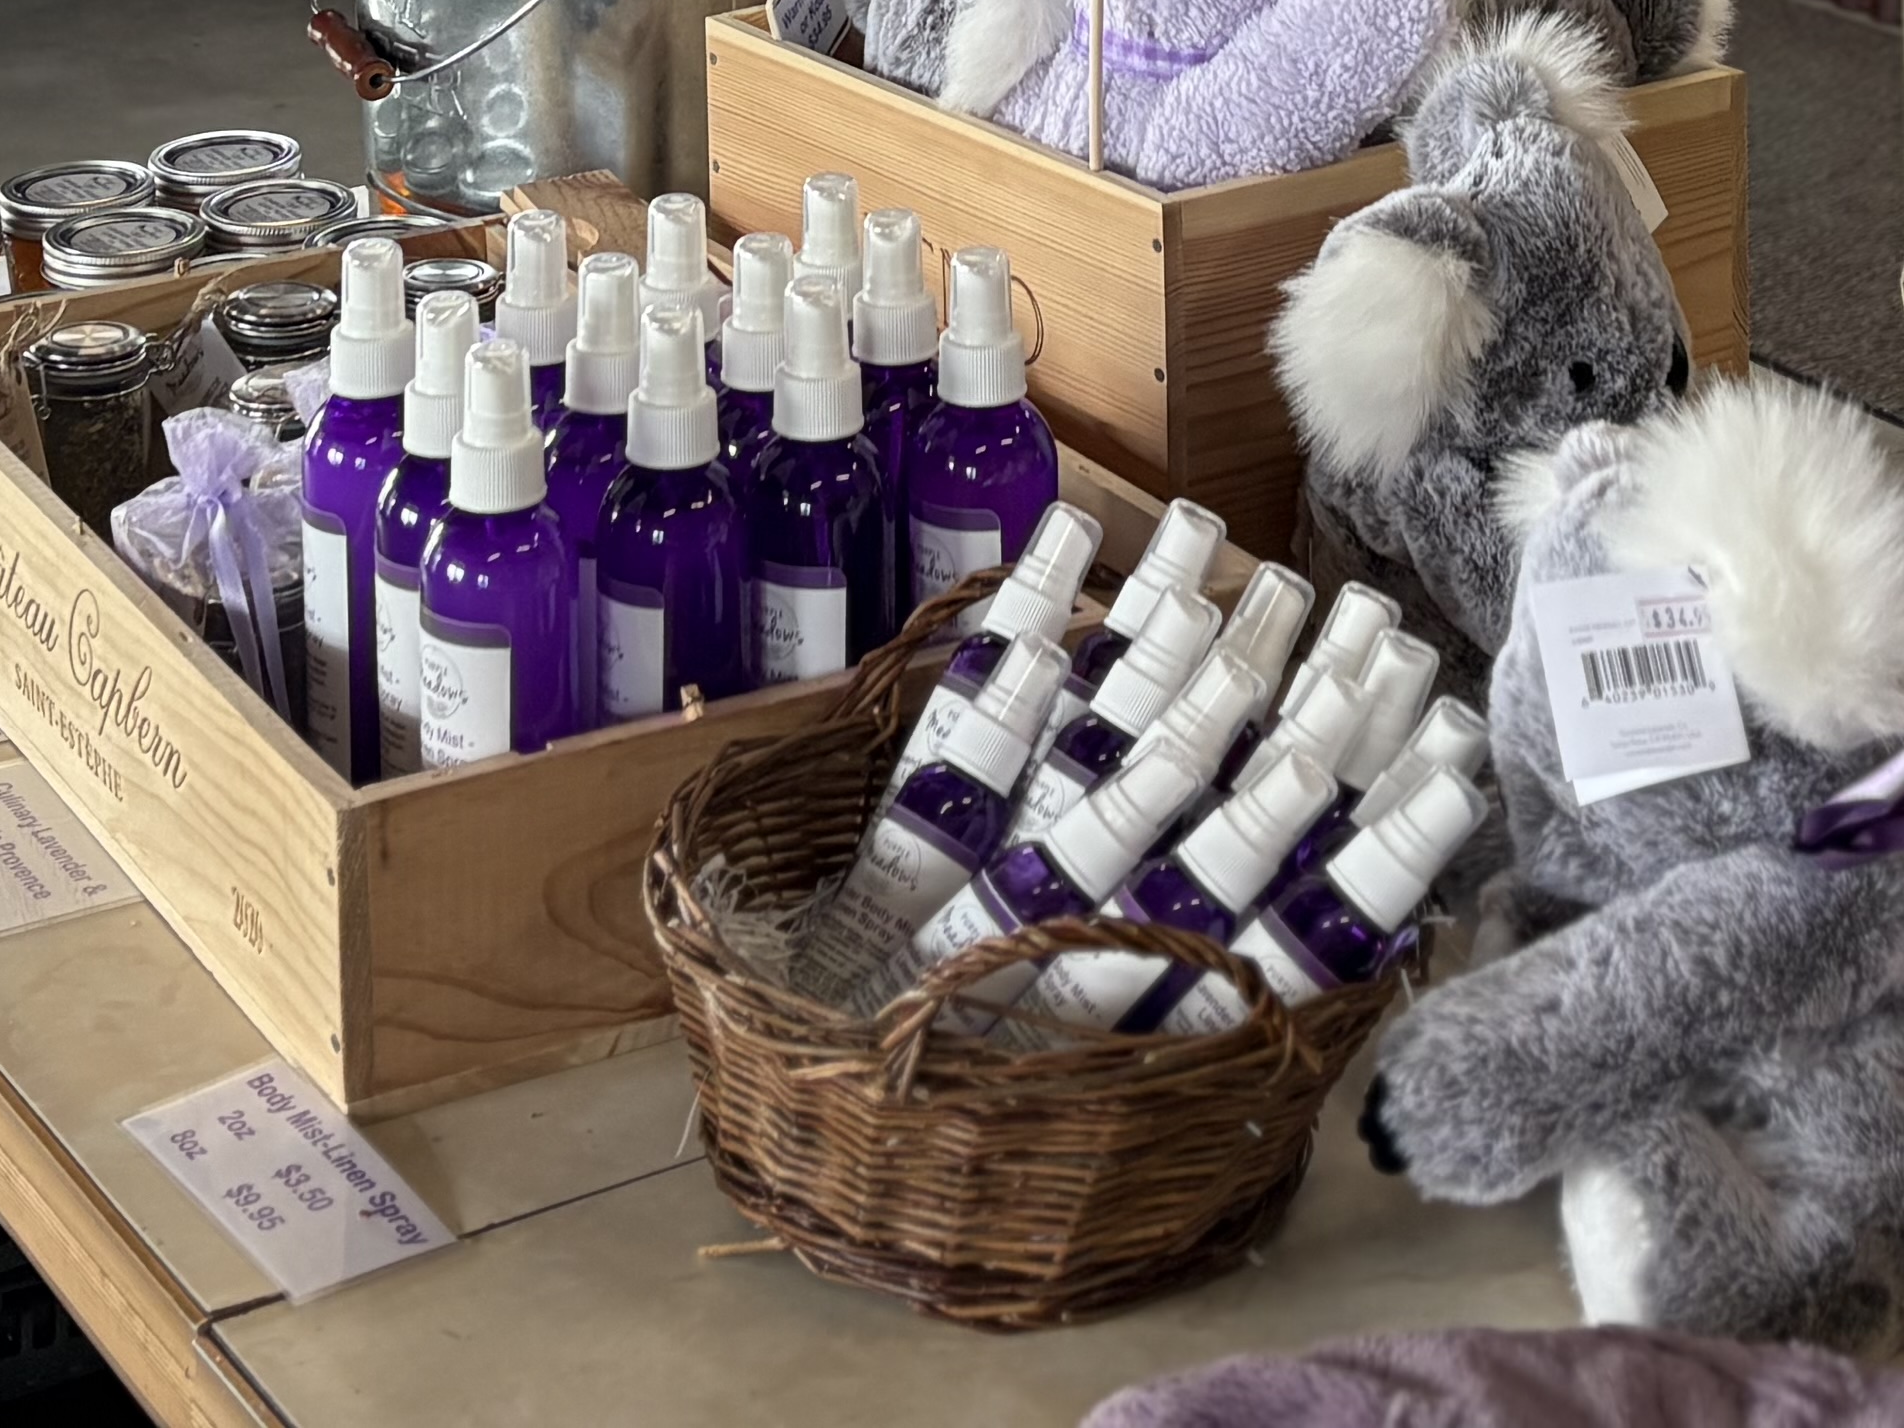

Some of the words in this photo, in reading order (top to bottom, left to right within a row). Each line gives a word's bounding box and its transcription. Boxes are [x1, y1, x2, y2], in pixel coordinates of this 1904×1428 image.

[68, 589, 187, 790] Capbern
[31, 826, 92, 885] Lavender
[83, 882, 108, 897] &
[170, 1129, 209, 1161] 8oz
[222, 1183, 286, 1232] $9.95
[217, 1109, 257, 1142] 2oz
[271, 1163, 334, 1213] $3.50
[246, 1072, 296, 1115] Body
[286, 1109, 377, 1195] Mist-Linen
[368, 1190, 429, 1246] Spray
